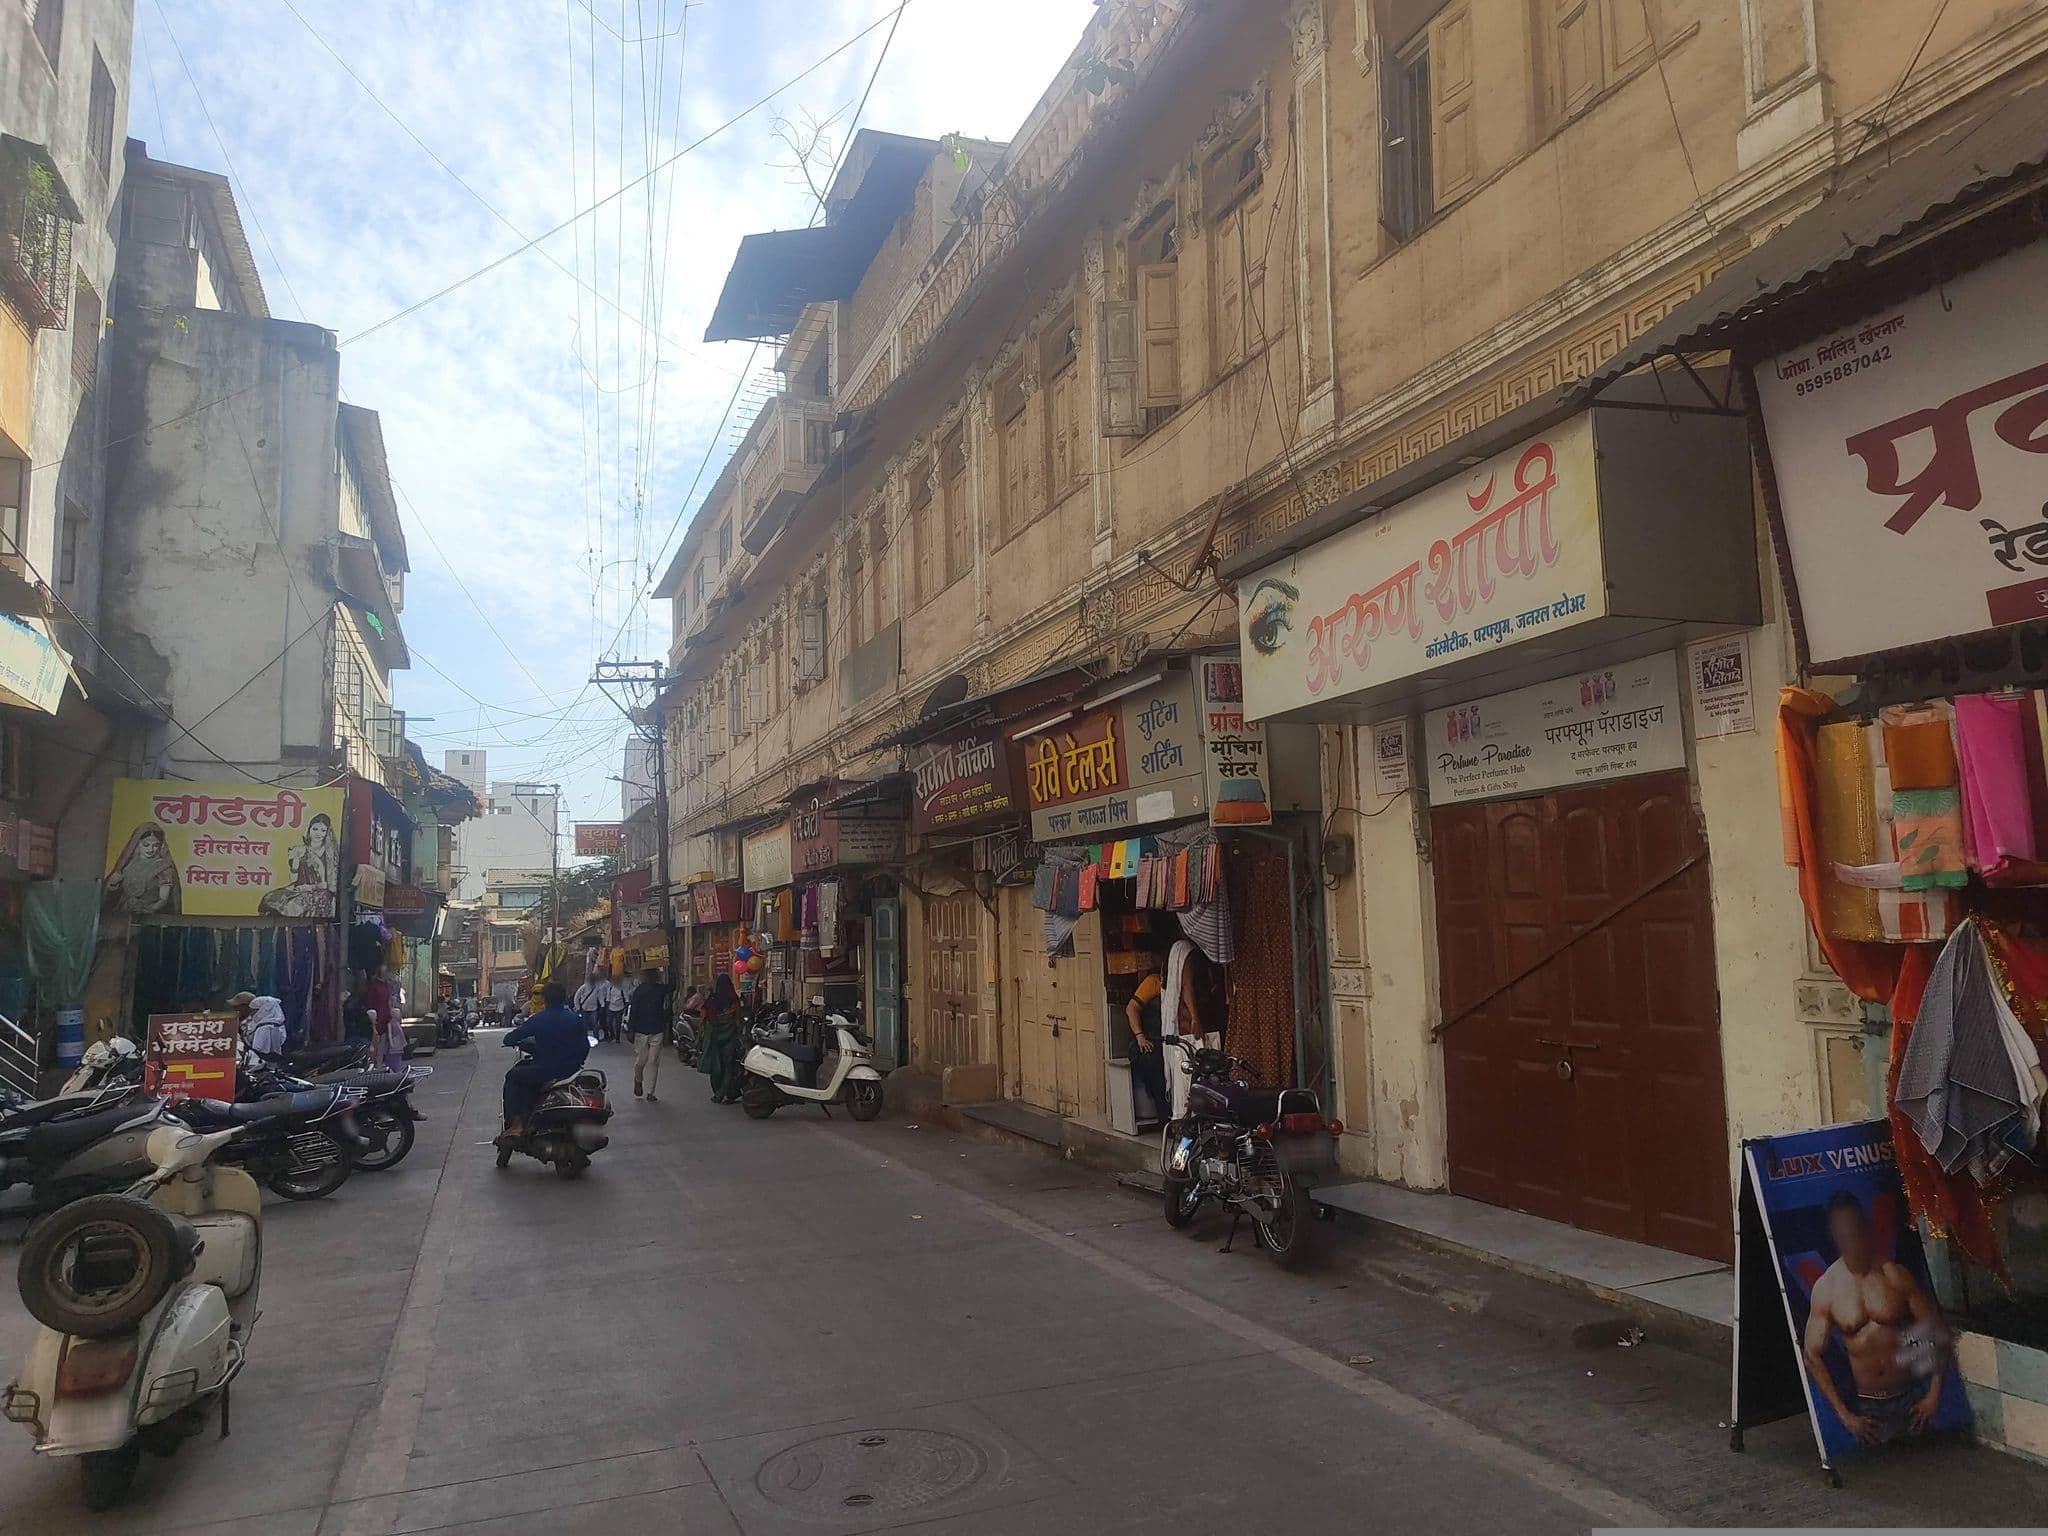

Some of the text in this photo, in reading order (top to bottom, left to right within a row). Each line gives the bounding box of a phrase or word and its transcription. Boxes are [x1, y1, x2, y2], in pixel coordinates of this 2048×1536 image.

[1817, 336, 1857, 365] मिलिंद
[1796, 345, 1892, 396] 9595887042
[1305, 442, 1559, 695] अरुण शॉपी
[1515, 606, 1549, 629] जनरल
[1552, 593, 1586, 618] स्टोअर
[1715, 691, 1748, 702] Management
[1137, 699, 1178, 741] सुटिंग
[1544, 720, 1594, 746] परफ्यूम
[1597, 705, 1665, 734] पॅराडाइज
[1029, 716, 1119, 803] रवि टेलर्स
[1141, 738, 1183, 775] शर्टिंग
[1210, 735, 1263, 756] मॅचिंग
[1437, 744, 1532, 773] Perfume Paradise
[1218, 757, 1259, 777] सेंटर
[1446, 764, 1526, 785] The Perfect Perfume Hub
[1453, 786, 1480, 797] Perfumes
[1502, 780, 1518, 790] Shop
[153, 790, 306, 829] लाडली
[193, 834, 270, 857] होलसेल
[186, 864, 272, 886] मिल डेपो
[162, 1020, 225, 1036] प्रकाश
[1767, 1142, 1892, 1181] LUX VENUS
